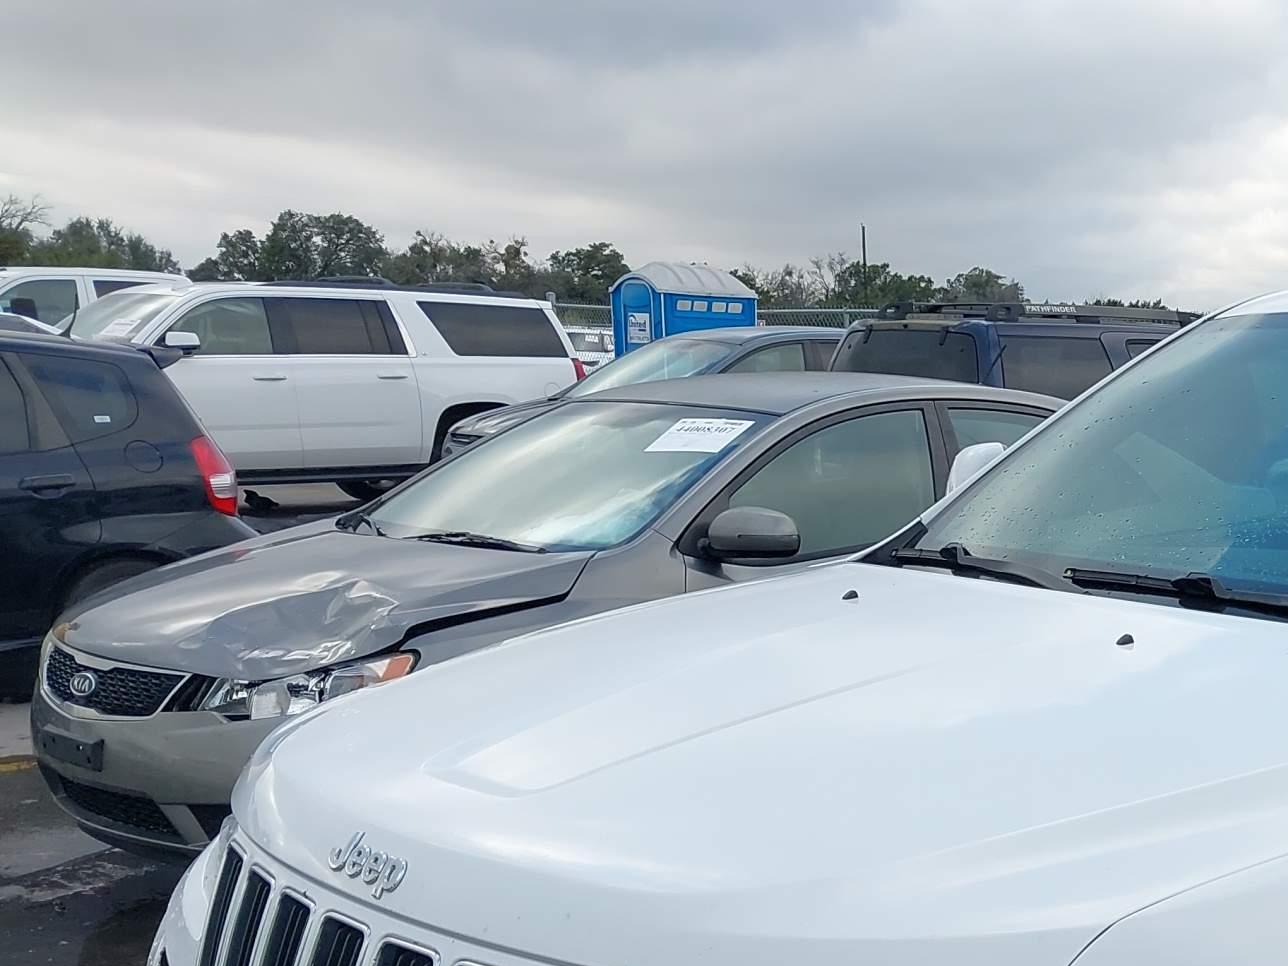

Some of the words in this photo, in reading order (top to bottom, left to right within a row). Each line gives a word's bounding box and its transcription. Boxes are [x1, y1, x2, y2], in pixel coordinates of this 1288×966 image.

[1025, 305, 1077, 314] PATHFINDER
[73, 677, 90, 692] KIA
[328, 831, 408, 900] Jeep
